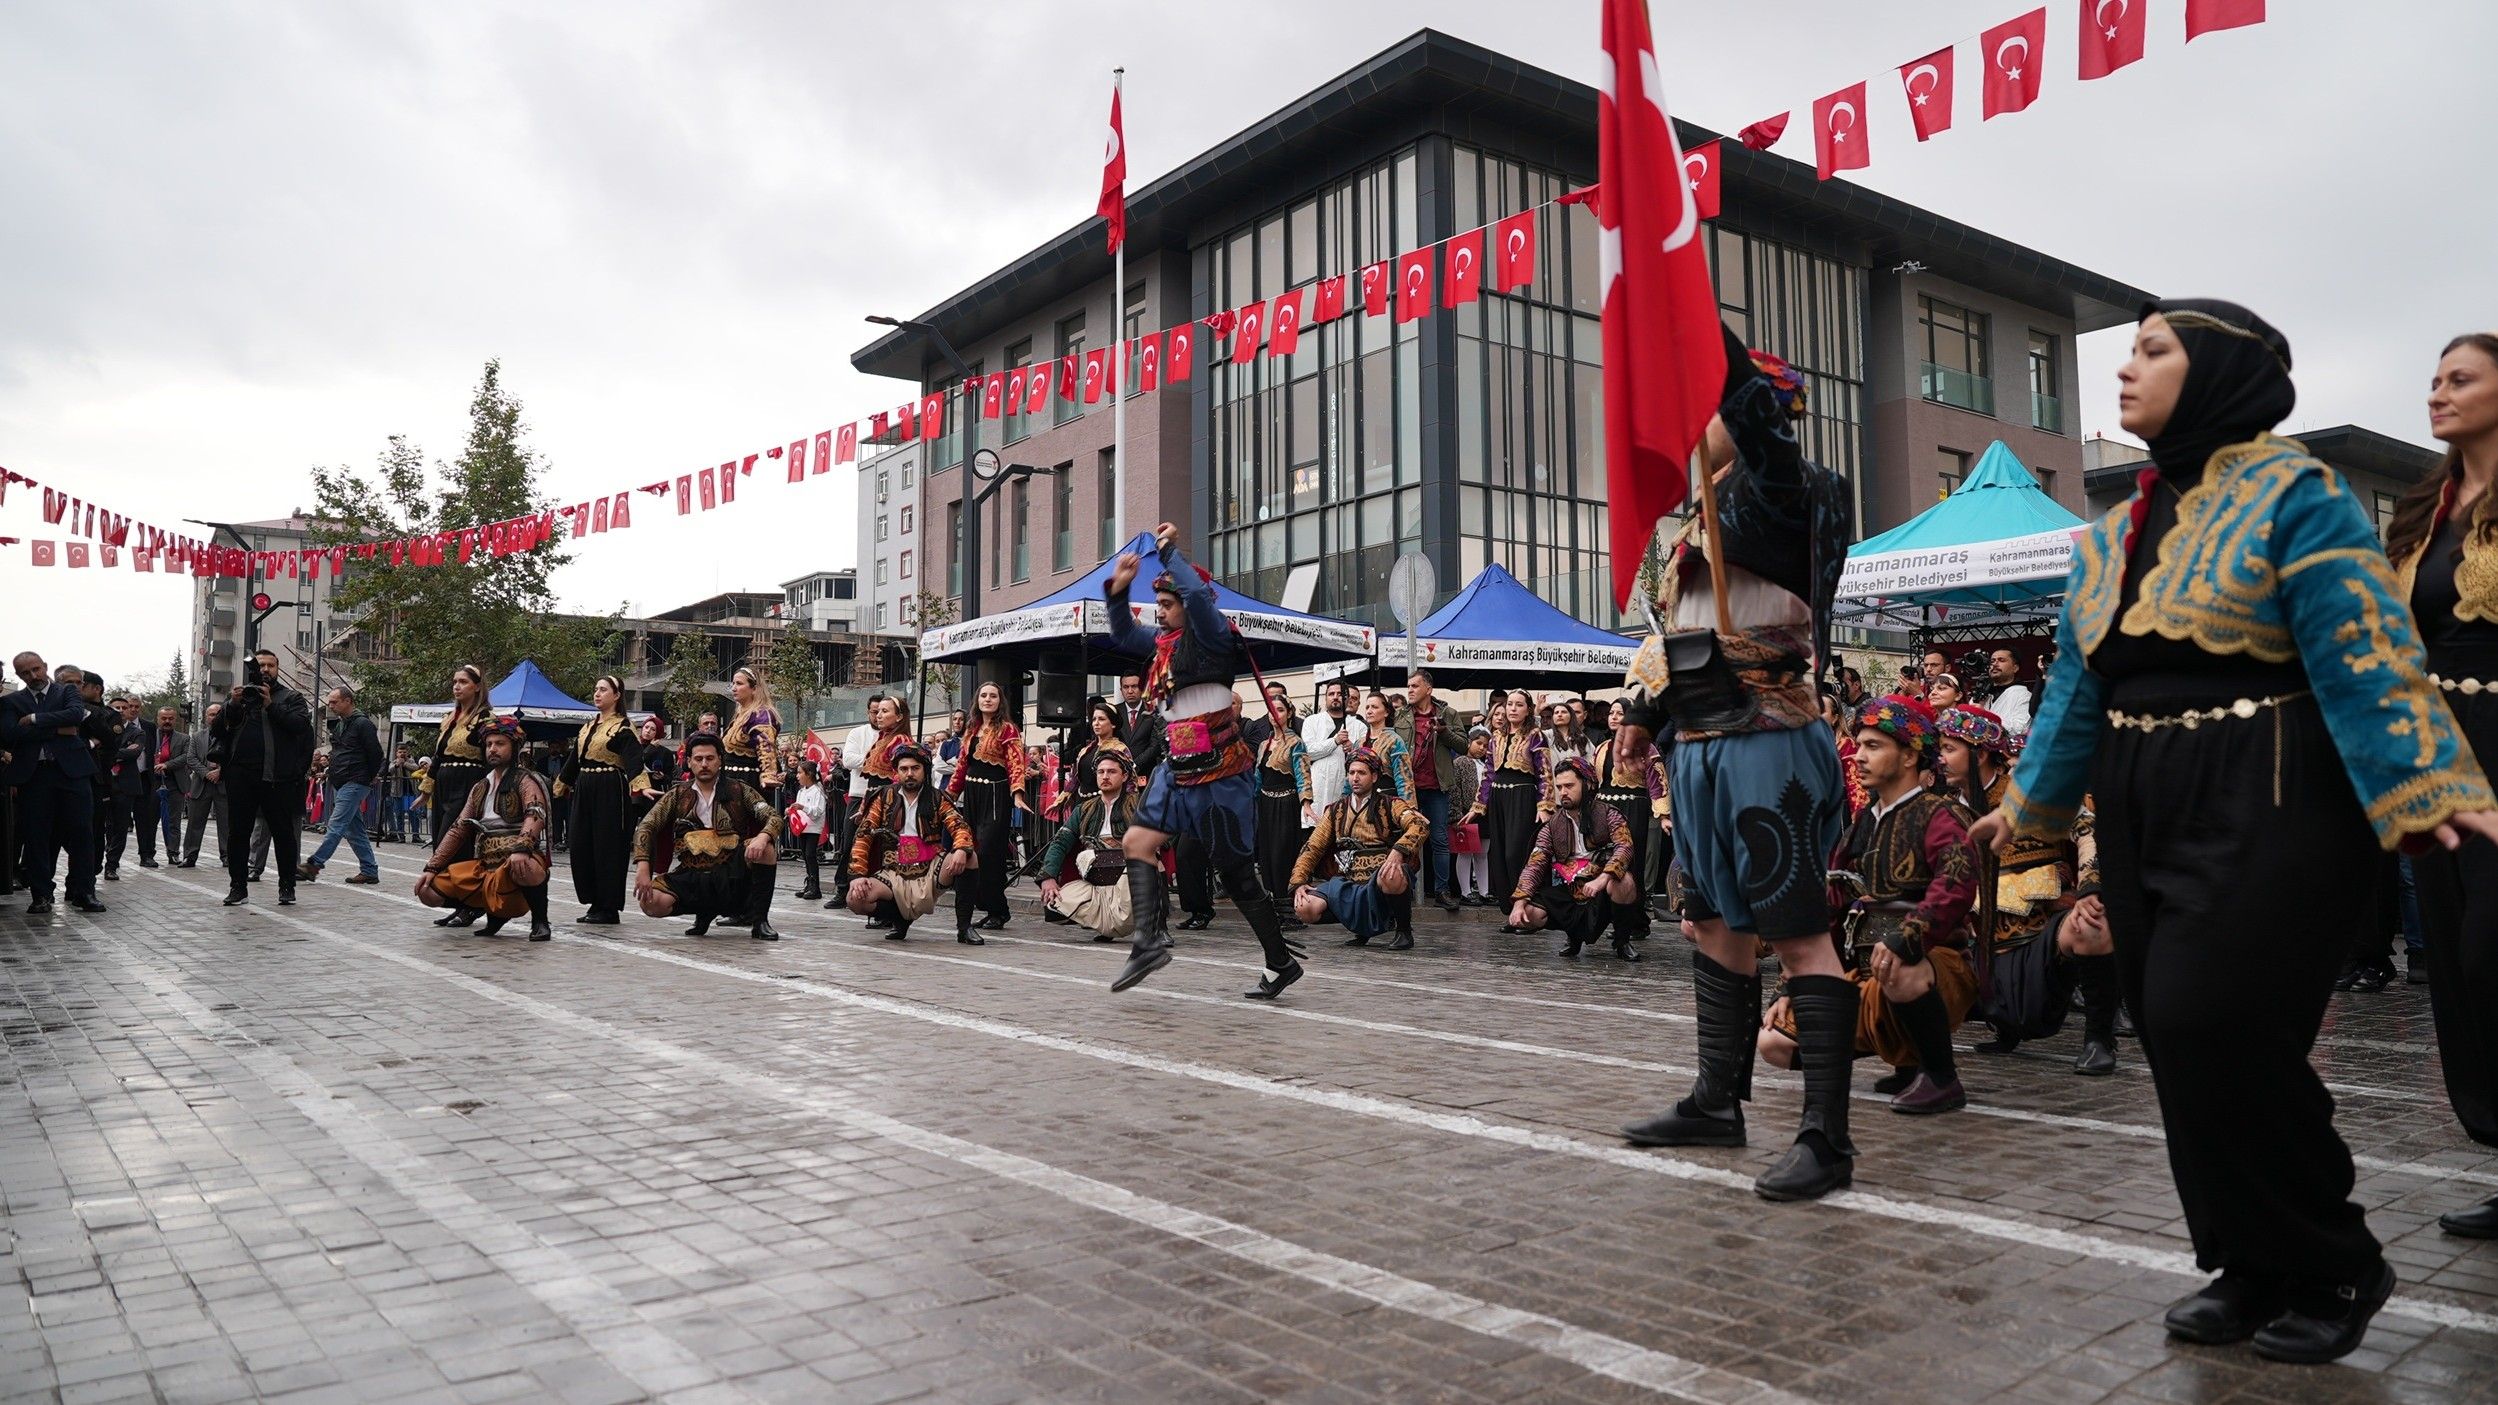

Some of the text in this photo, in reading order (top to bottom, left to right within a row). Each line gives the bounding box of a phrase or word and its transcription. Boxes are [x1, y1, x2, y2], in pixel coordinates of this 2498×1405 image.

[1844, 549, 1969, 576] hramanmaraş
[1989, 545, 2071, 563] Kahramanmaraş
[2031, 559, 2070, 572] Belediyesi
[1837, 568, 1968, 596] yükşehir Belediyesi
[1238, 612, 1284, 633] Büyükşehir
[1448, 645, 1631, 668] Kahramanmaraş Büyükşehir Belediyesi
